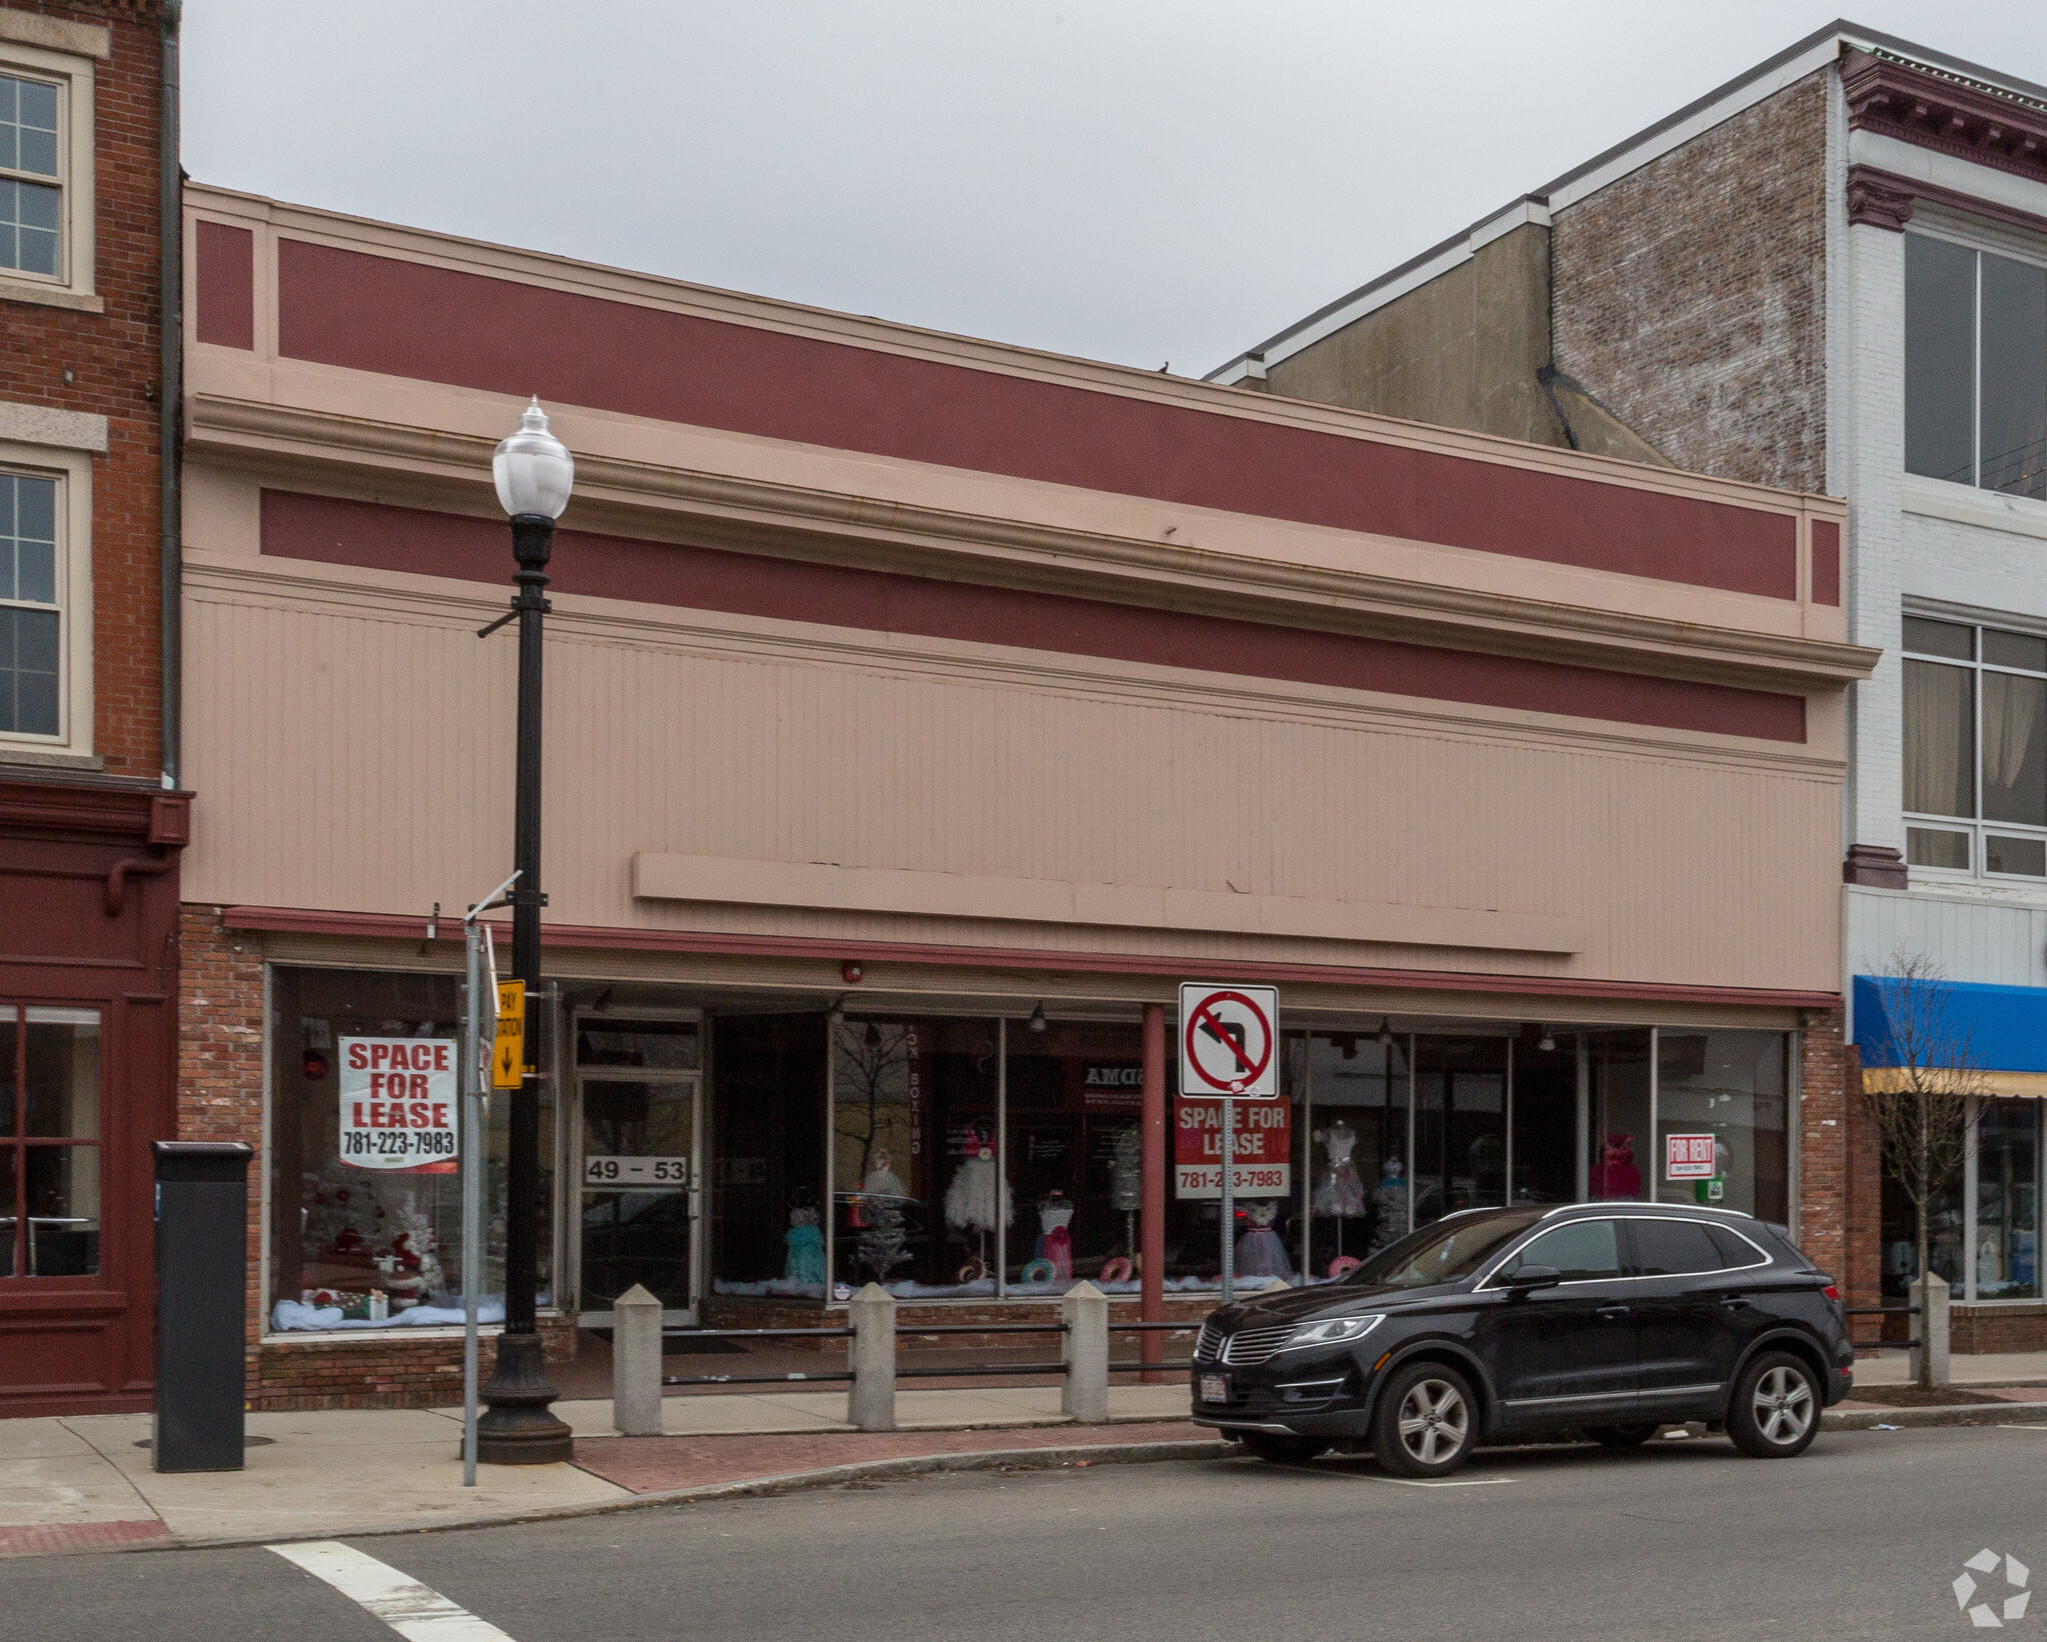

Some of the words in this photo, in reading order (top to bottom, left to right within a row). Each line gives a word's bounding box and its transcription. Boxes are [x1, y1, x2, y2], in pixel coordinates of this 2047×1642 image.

[348, 1043, 449, 1071] SPACE
[370, 1073, 428, 1099] FOR
[352, 1102, 449, 1128] LEASE
[1249, 1107, 1285, 1128] FOR
[343, 1131, 454, 1154] 781-223-7983
[588, 1160, 619, 1179] 49
[654, 1161, 685, 1180] 53
[1180, 1170, 1282, 1188] 781-23-7983
